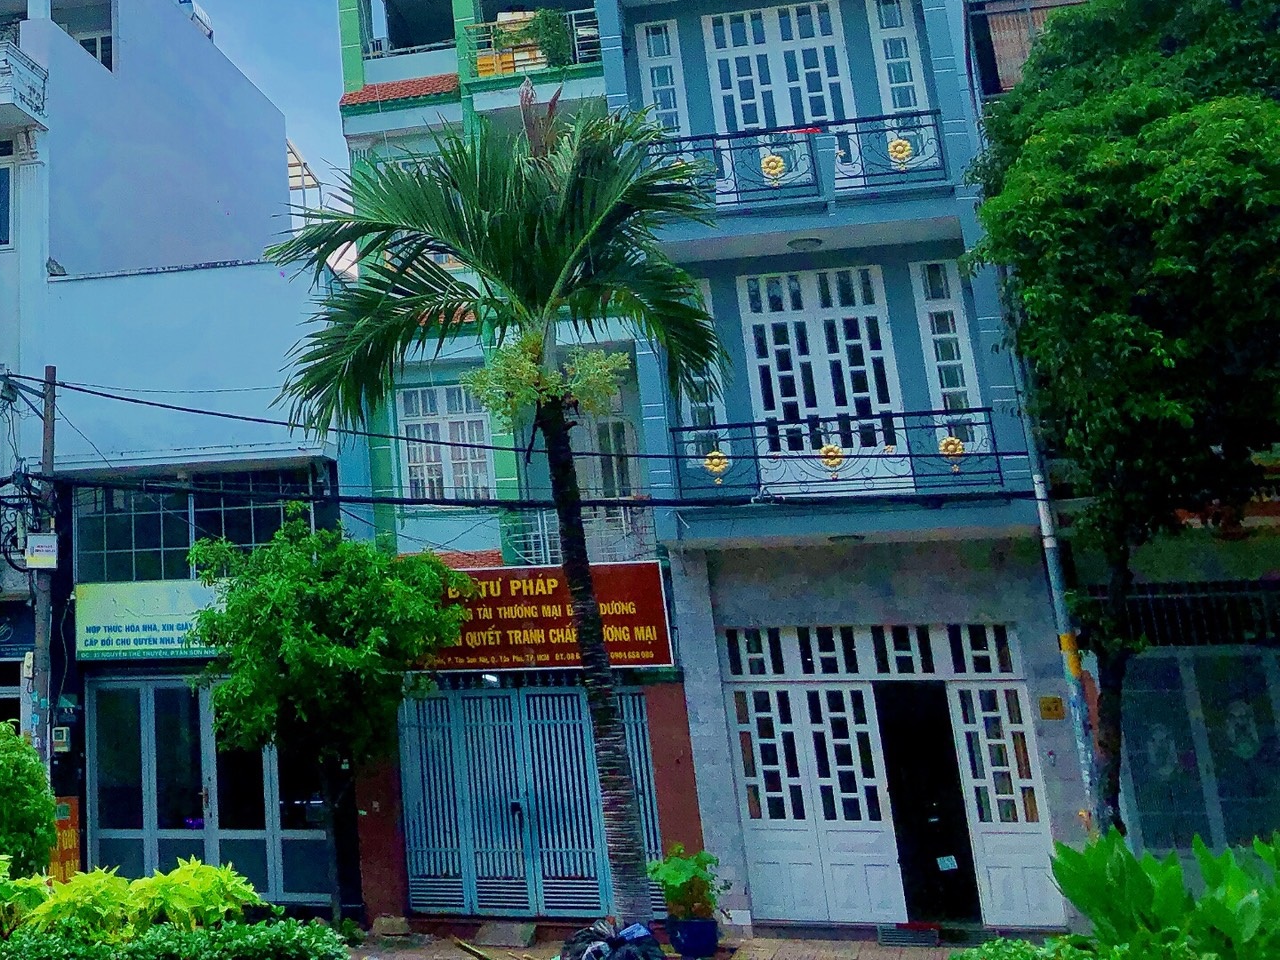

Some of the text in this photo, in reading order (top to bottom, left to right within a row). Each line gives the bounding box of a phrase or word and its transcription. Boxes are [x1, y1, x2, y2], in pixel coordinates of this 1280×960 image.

[477, 577, 502, 598] TƯ
[509, 573, 559, 597] PHÁP
[477, 604, 493, 620] TÀI
[497, 602, 539, 619] THƯƠNG
[541, 604, 562, 620] MẠI
[599, 600, 637, 615] DƯƠNG
[161, 623, 174, 632] XIN
[465, 624, 502, 648] QUYẾT
[506, 628, 545, 645] TRANH
[633, 625, 658, 645] MẠI
